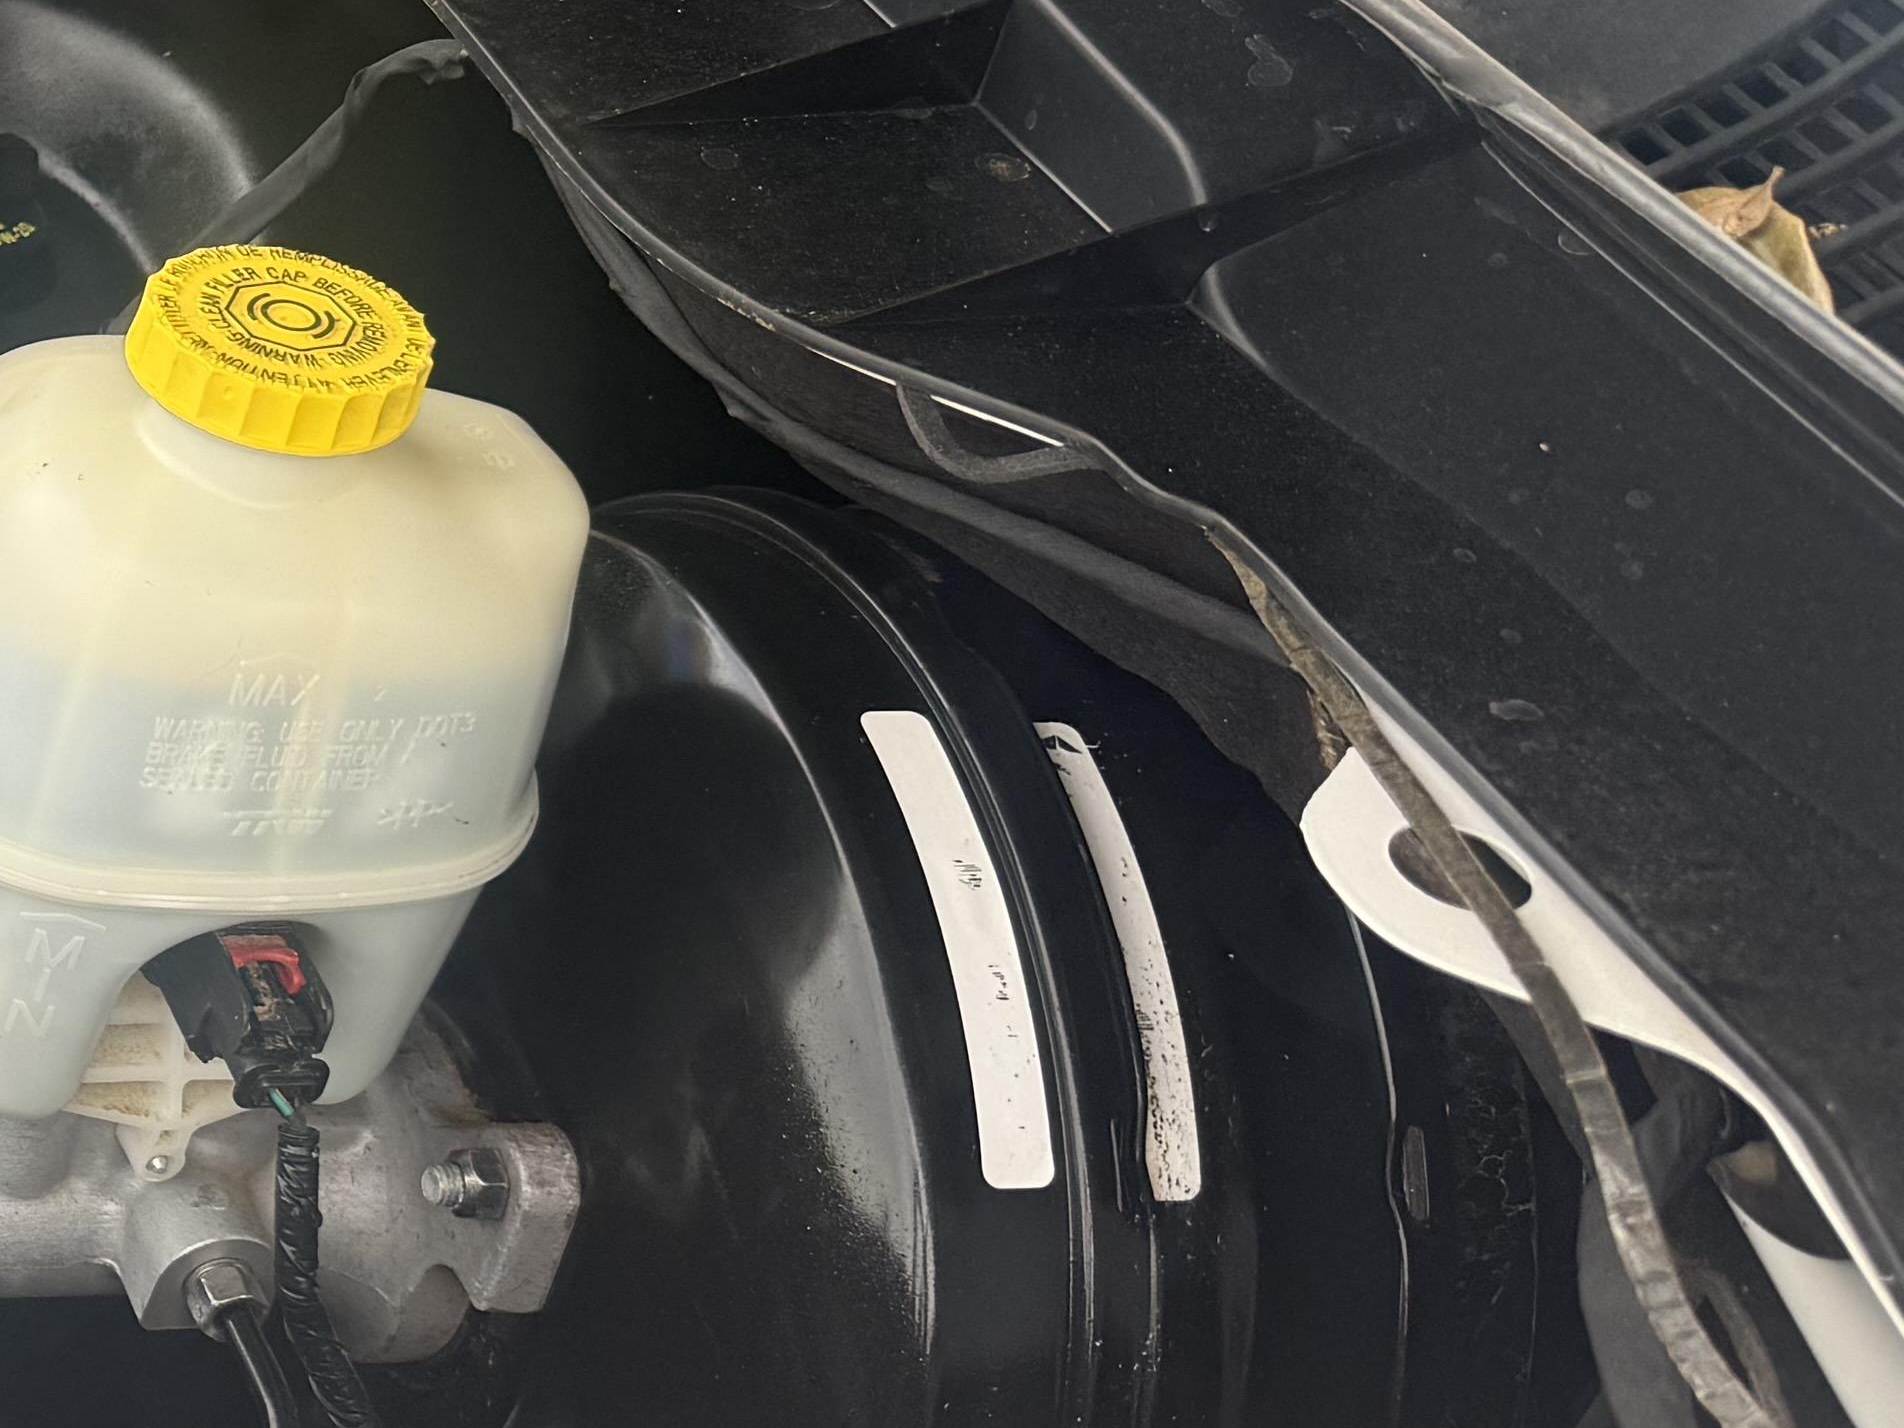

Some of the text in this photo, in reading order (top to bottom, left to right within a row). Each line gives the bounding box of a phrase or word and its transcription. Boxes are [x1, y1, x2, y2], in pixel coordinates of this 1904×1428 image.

[241, 246, 263, 259] DE
[212, 266, 262, 292] FILLER
[266, 266, 307, 283] CAP
[311, 277, 377, 319] BEFORE
[328, 319, 388, 367] REMOVING
[227, 672, 321, 707] MAX
[279, 718, 322, 743] USE
[338, 717, 405, 743] ONLY
[415, 710, 477, 737] DOT3
[145, 742, 386, 767] BRAKE FLUID FROM
[249, 768, 381, 792] CONTAINER
[3, 927, 85, 1037] MIN
